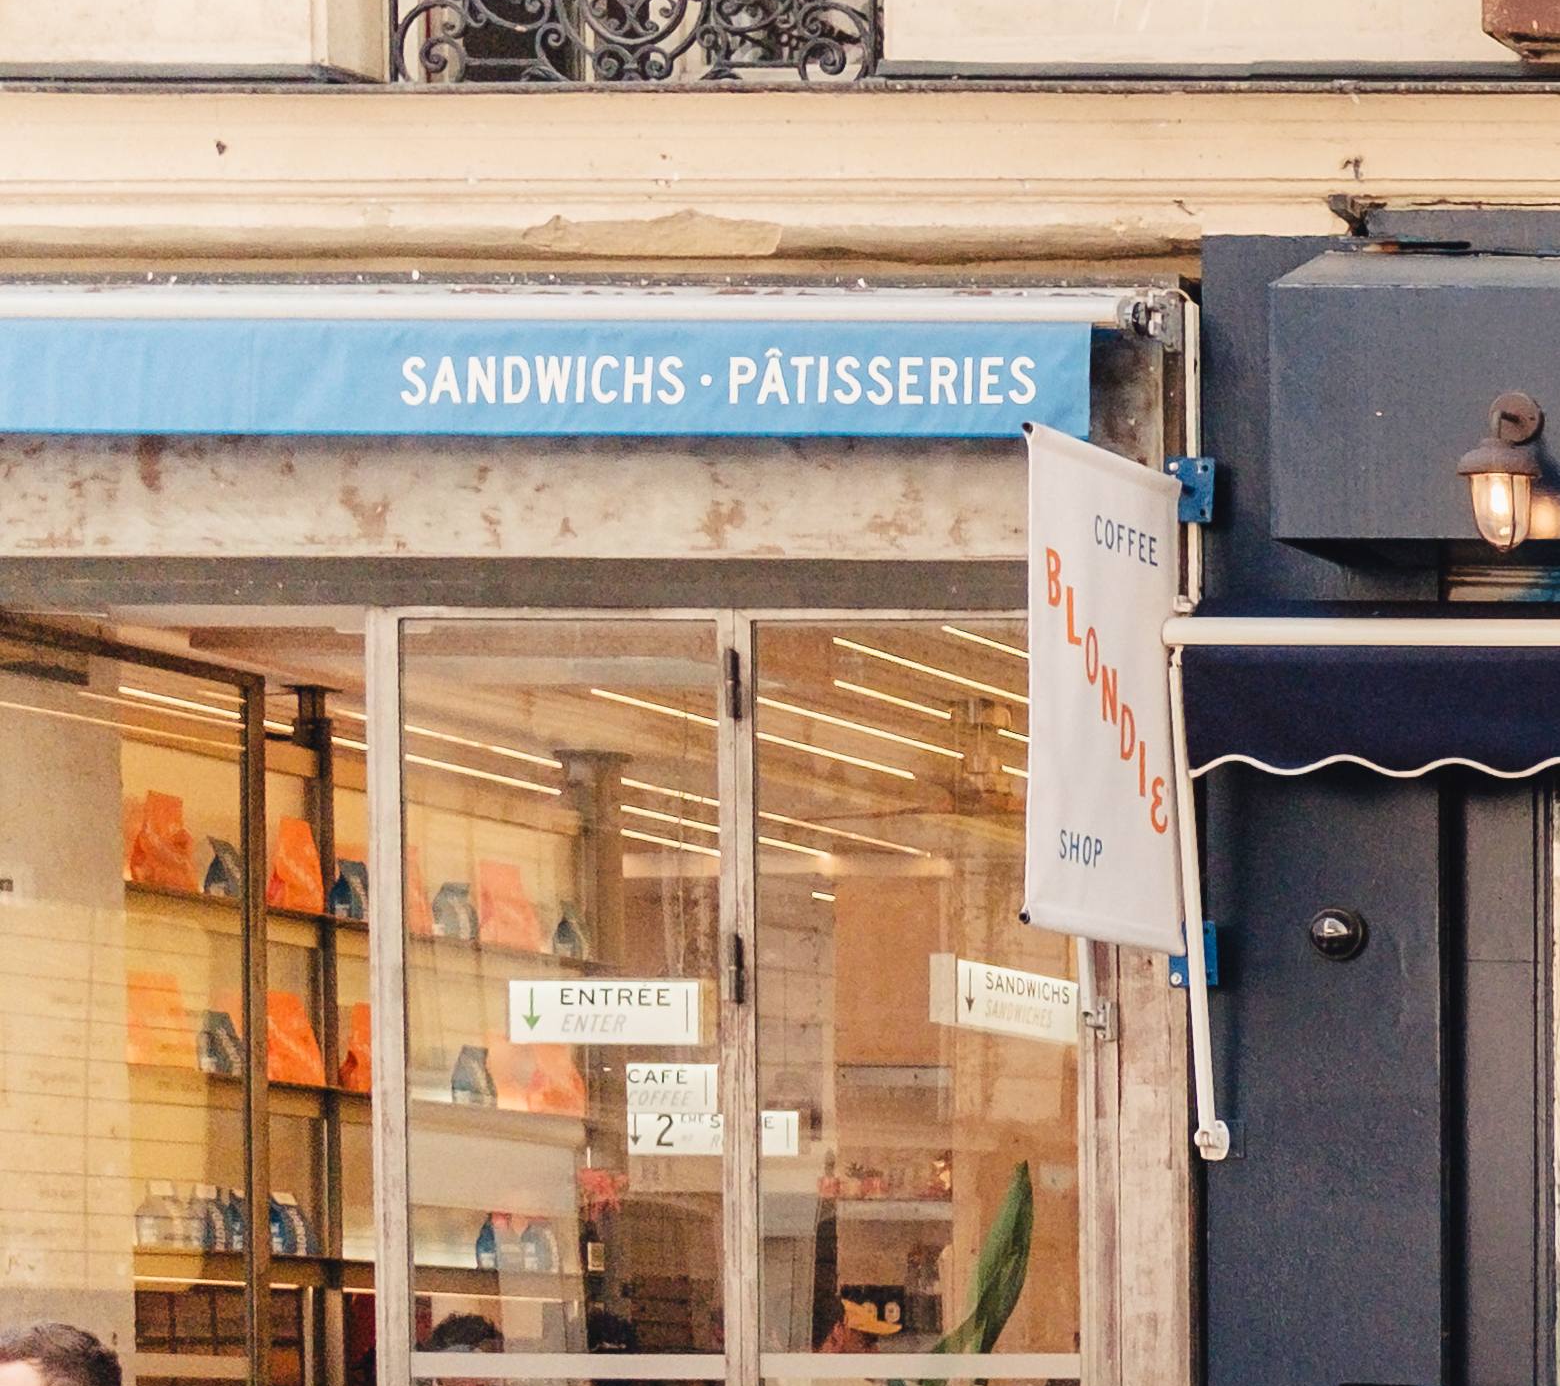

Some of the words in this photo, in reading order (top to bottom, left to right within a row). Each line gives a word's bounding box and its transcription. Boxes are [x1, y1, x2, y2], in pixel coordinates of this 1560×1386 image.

[401, 353, 686, 406] SANDWICHS
[729, 347, 1037, 406] PÂTISSERIES
[1095, 514, 1158, 567] COFFEE
[1045, 546, 1168, 834] BLONDIE
[1059, 829, 1103, 868] SHOP
[560, 983, 672, 1007] ENTRÉE
[985, 972, 1070, 1004] SANDWICHS
[561, 1014, 626, 1034] ENTER
[628, 1090, 693, 1106] COFFEE
